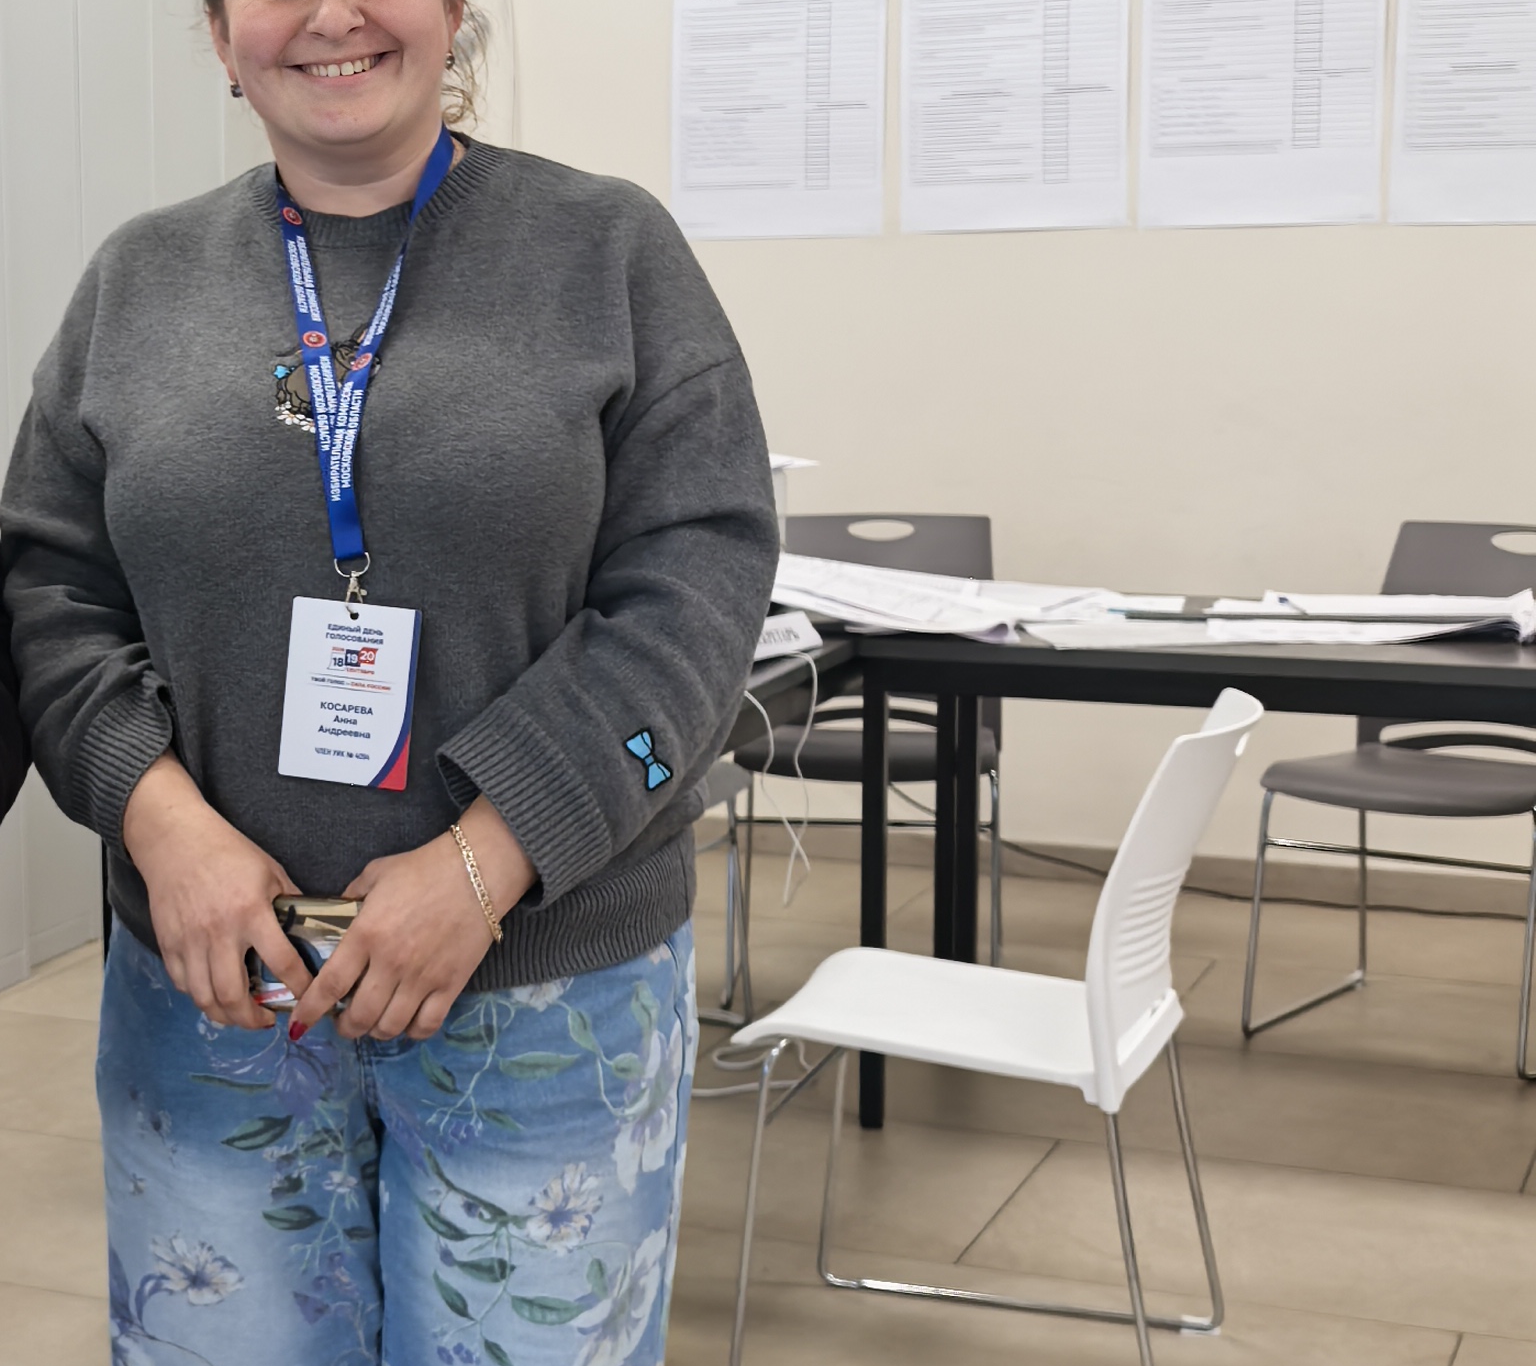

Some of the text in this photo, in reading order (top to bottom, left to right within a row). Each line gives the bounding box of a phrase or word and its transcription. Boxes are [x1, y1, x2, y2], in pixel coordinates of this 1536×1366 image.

[308, 365, 331, 451] МОСКОВСКОЙ ОБЛАСТИ
[330, 381, 354, 502] ИЗБИРАТЕЛЬНАЯ КОМИССИЯ
[341, 389, 364, 488] МОСКОВСКОЙ ОБЛАСТИ
[327, 623, 384, 636] ЕДИНЫЙ ДЕНЬ
[326, 632, 384, 645] ГОЛОСОВАНИЯ
[333, 650, 375, 667] 18 19 20
[320, 701, 373, 715] КОСАРЕВА
[333, 715, 358, 725] Анна
[318, 725, 371, 739] Андреевна
